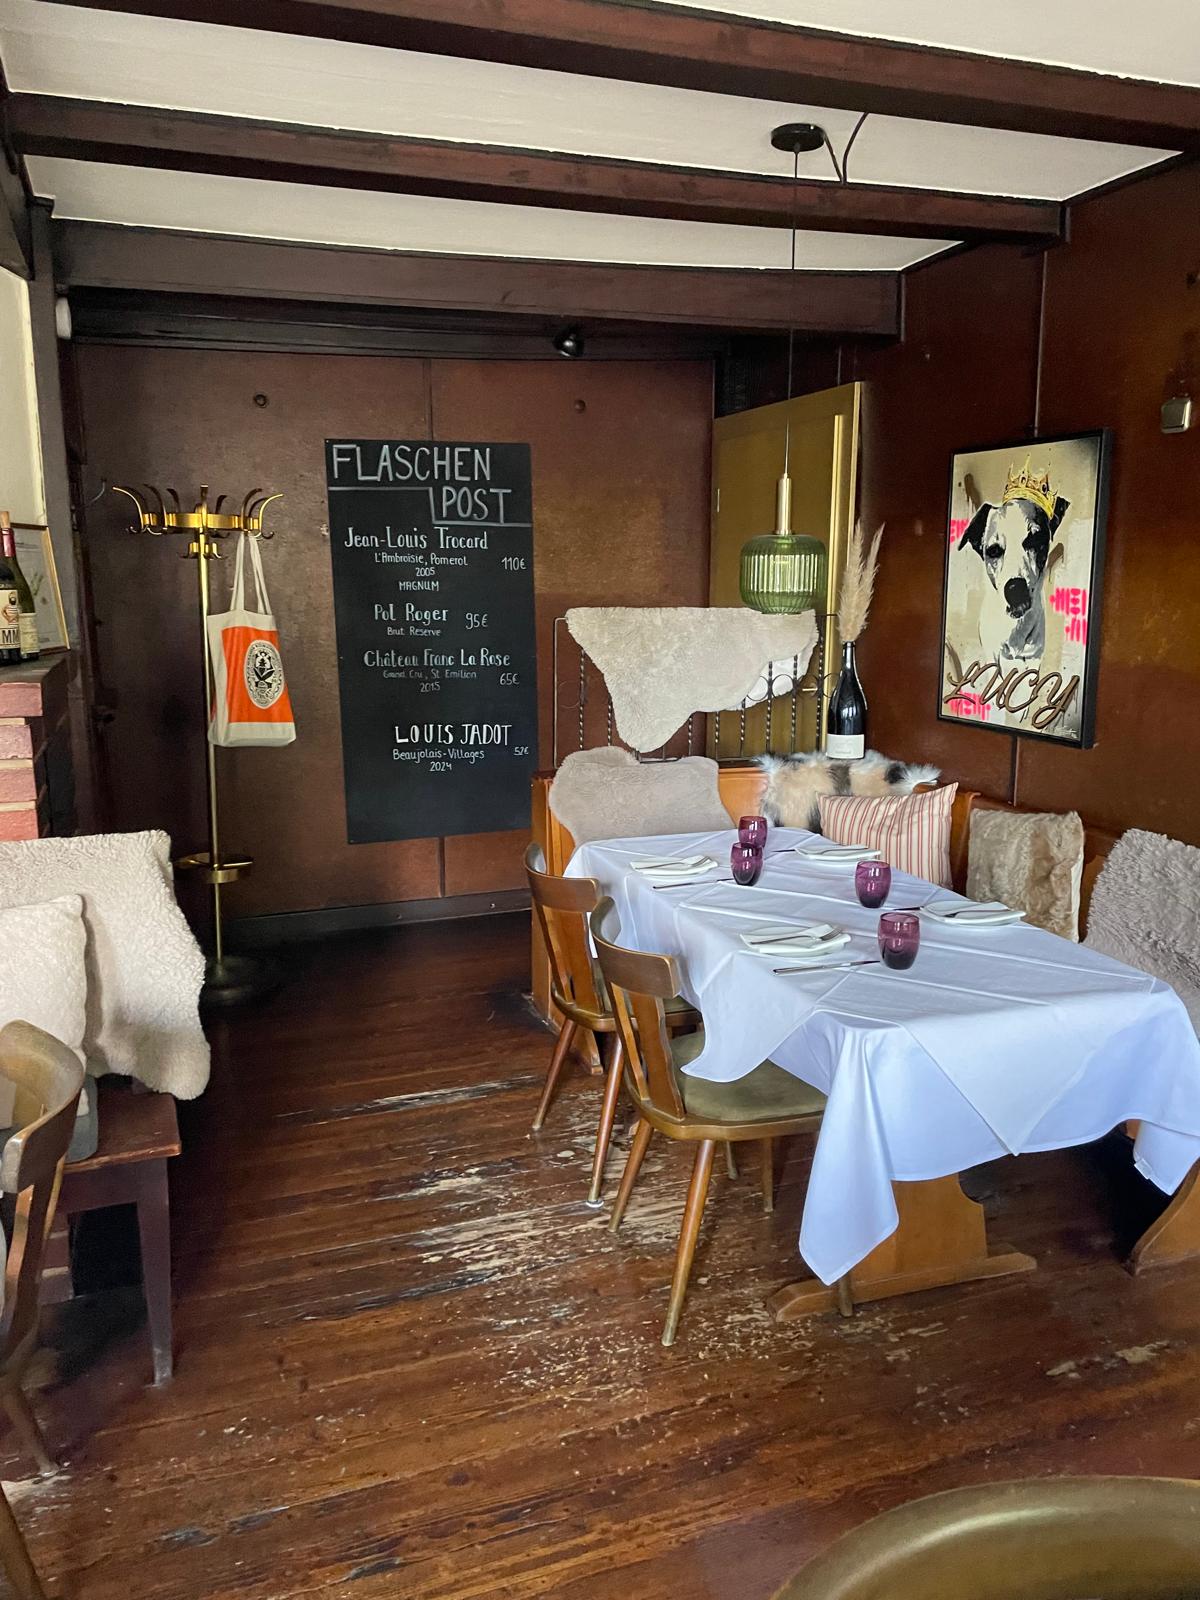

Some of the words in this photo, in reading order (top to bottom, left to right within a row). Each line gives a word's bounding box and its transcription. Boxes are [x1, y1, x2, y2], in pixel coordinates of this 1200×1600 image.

[333, 444, 490, 481] FLASCHEN
[442, 486, 512, 522] POST
[345, 527, 427, 548] Jean-Louis
[434, 527, 488, 549] Trocard
[431, 553, 469, 566] Pomerol
[502, 557, 526, 571] 110€
[416, 567, 436, 577] 2005
[399, 581, 440, 592] MAGNUM
[375, 604, 397, 621] Pol
[406, 603, 448, 625] Roger
[466, 613, 488, 630] 95€
[387, 627, 405, 636] Brut
[410, 626, 441, 637] Reserve
[364, 650, 419, 668] Château
[424, 649, 455, 667] Franc
[461, 649, 477, 666] La
[481, 648, 510, 666] Rose
[420, 682, 441, 693] 2015
[500, 673, 520, 686] 65€
[944, 661, 1080, 729] LUCY
[395, 724, 453, 744] LOUIS
[460, 724, 512, 745] JADOT
[393, 748, 485, 764] Beaujolais-Villages
[430, 761, 453, 772] 2024
